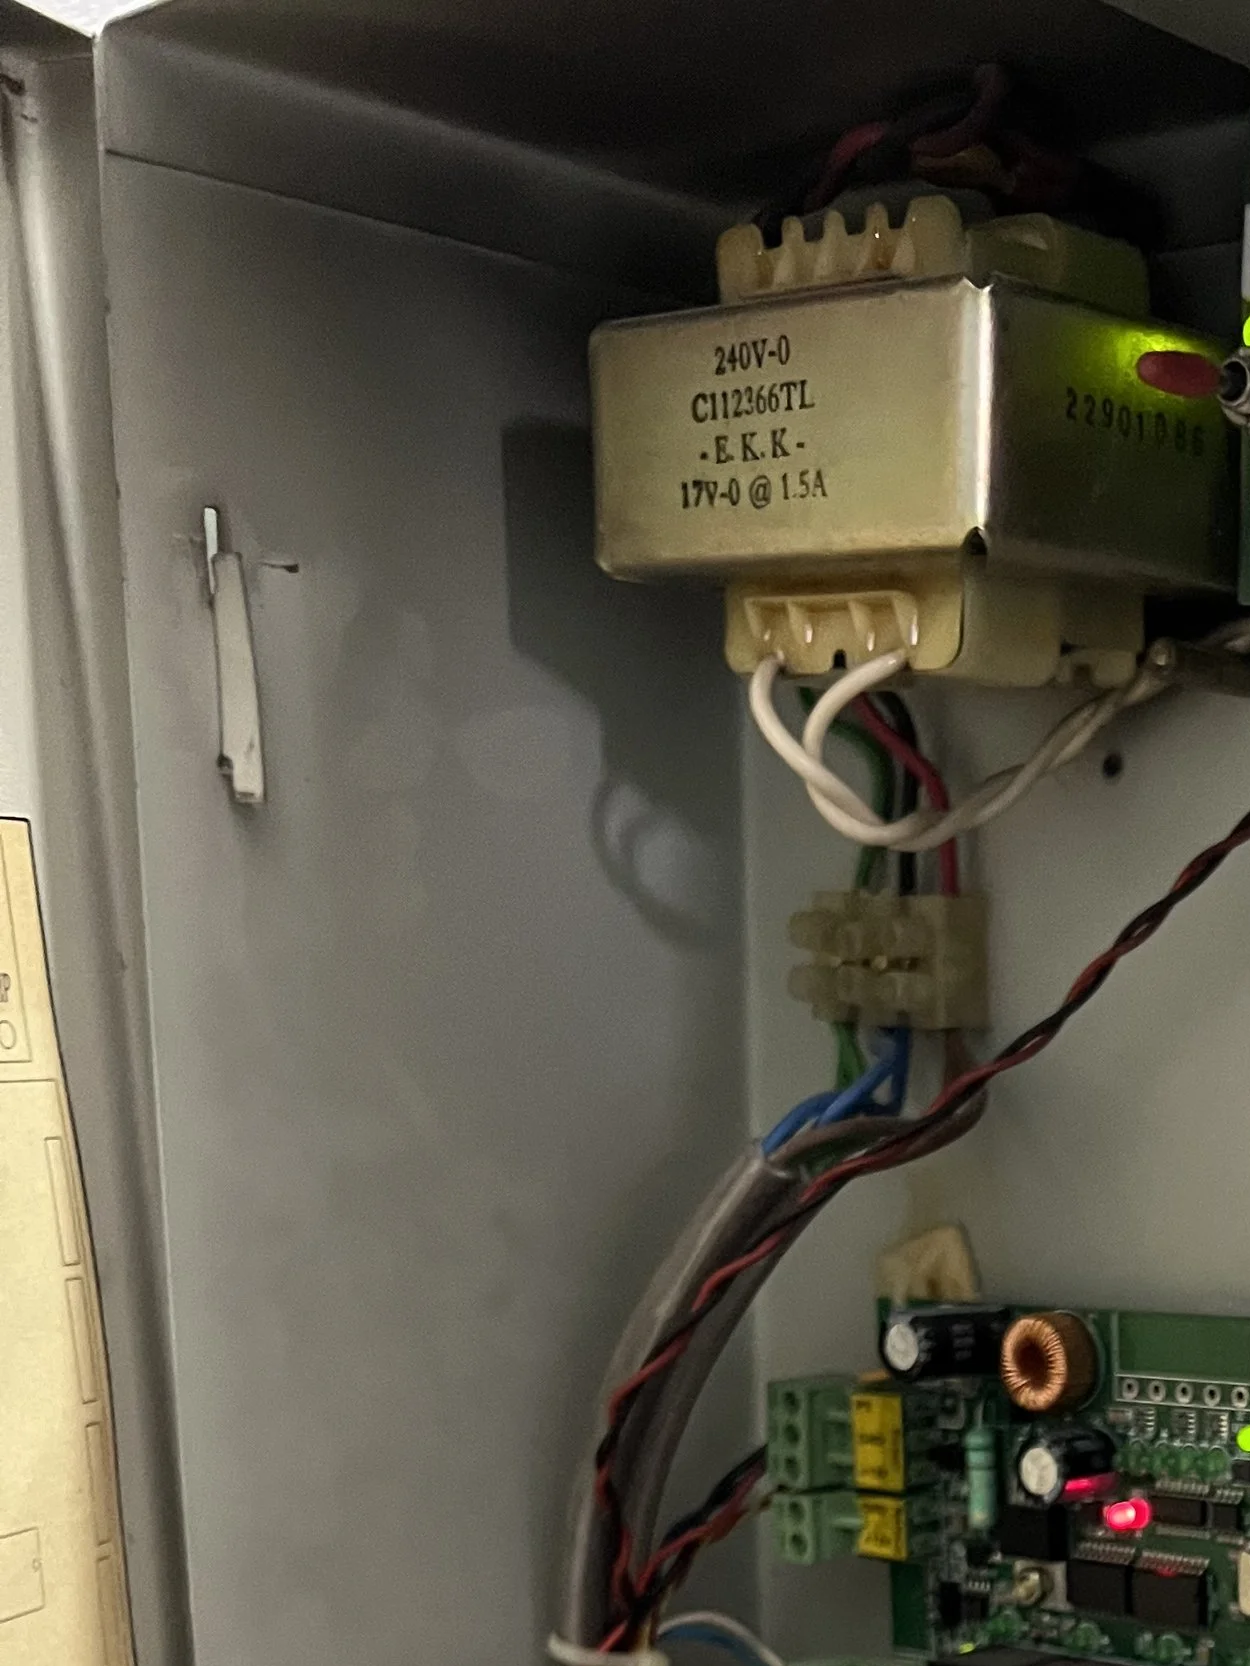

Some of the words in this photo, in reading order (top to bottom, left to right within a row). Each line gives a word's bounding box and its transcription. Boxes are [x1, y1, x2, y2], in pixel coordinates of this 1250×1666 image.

[714, 334, 790, 375] 240V-0
[681, 477, 740, 509] 17V-0
[749, 474, 772, 509] @
[781, 468, 828, 500] 1.5A
